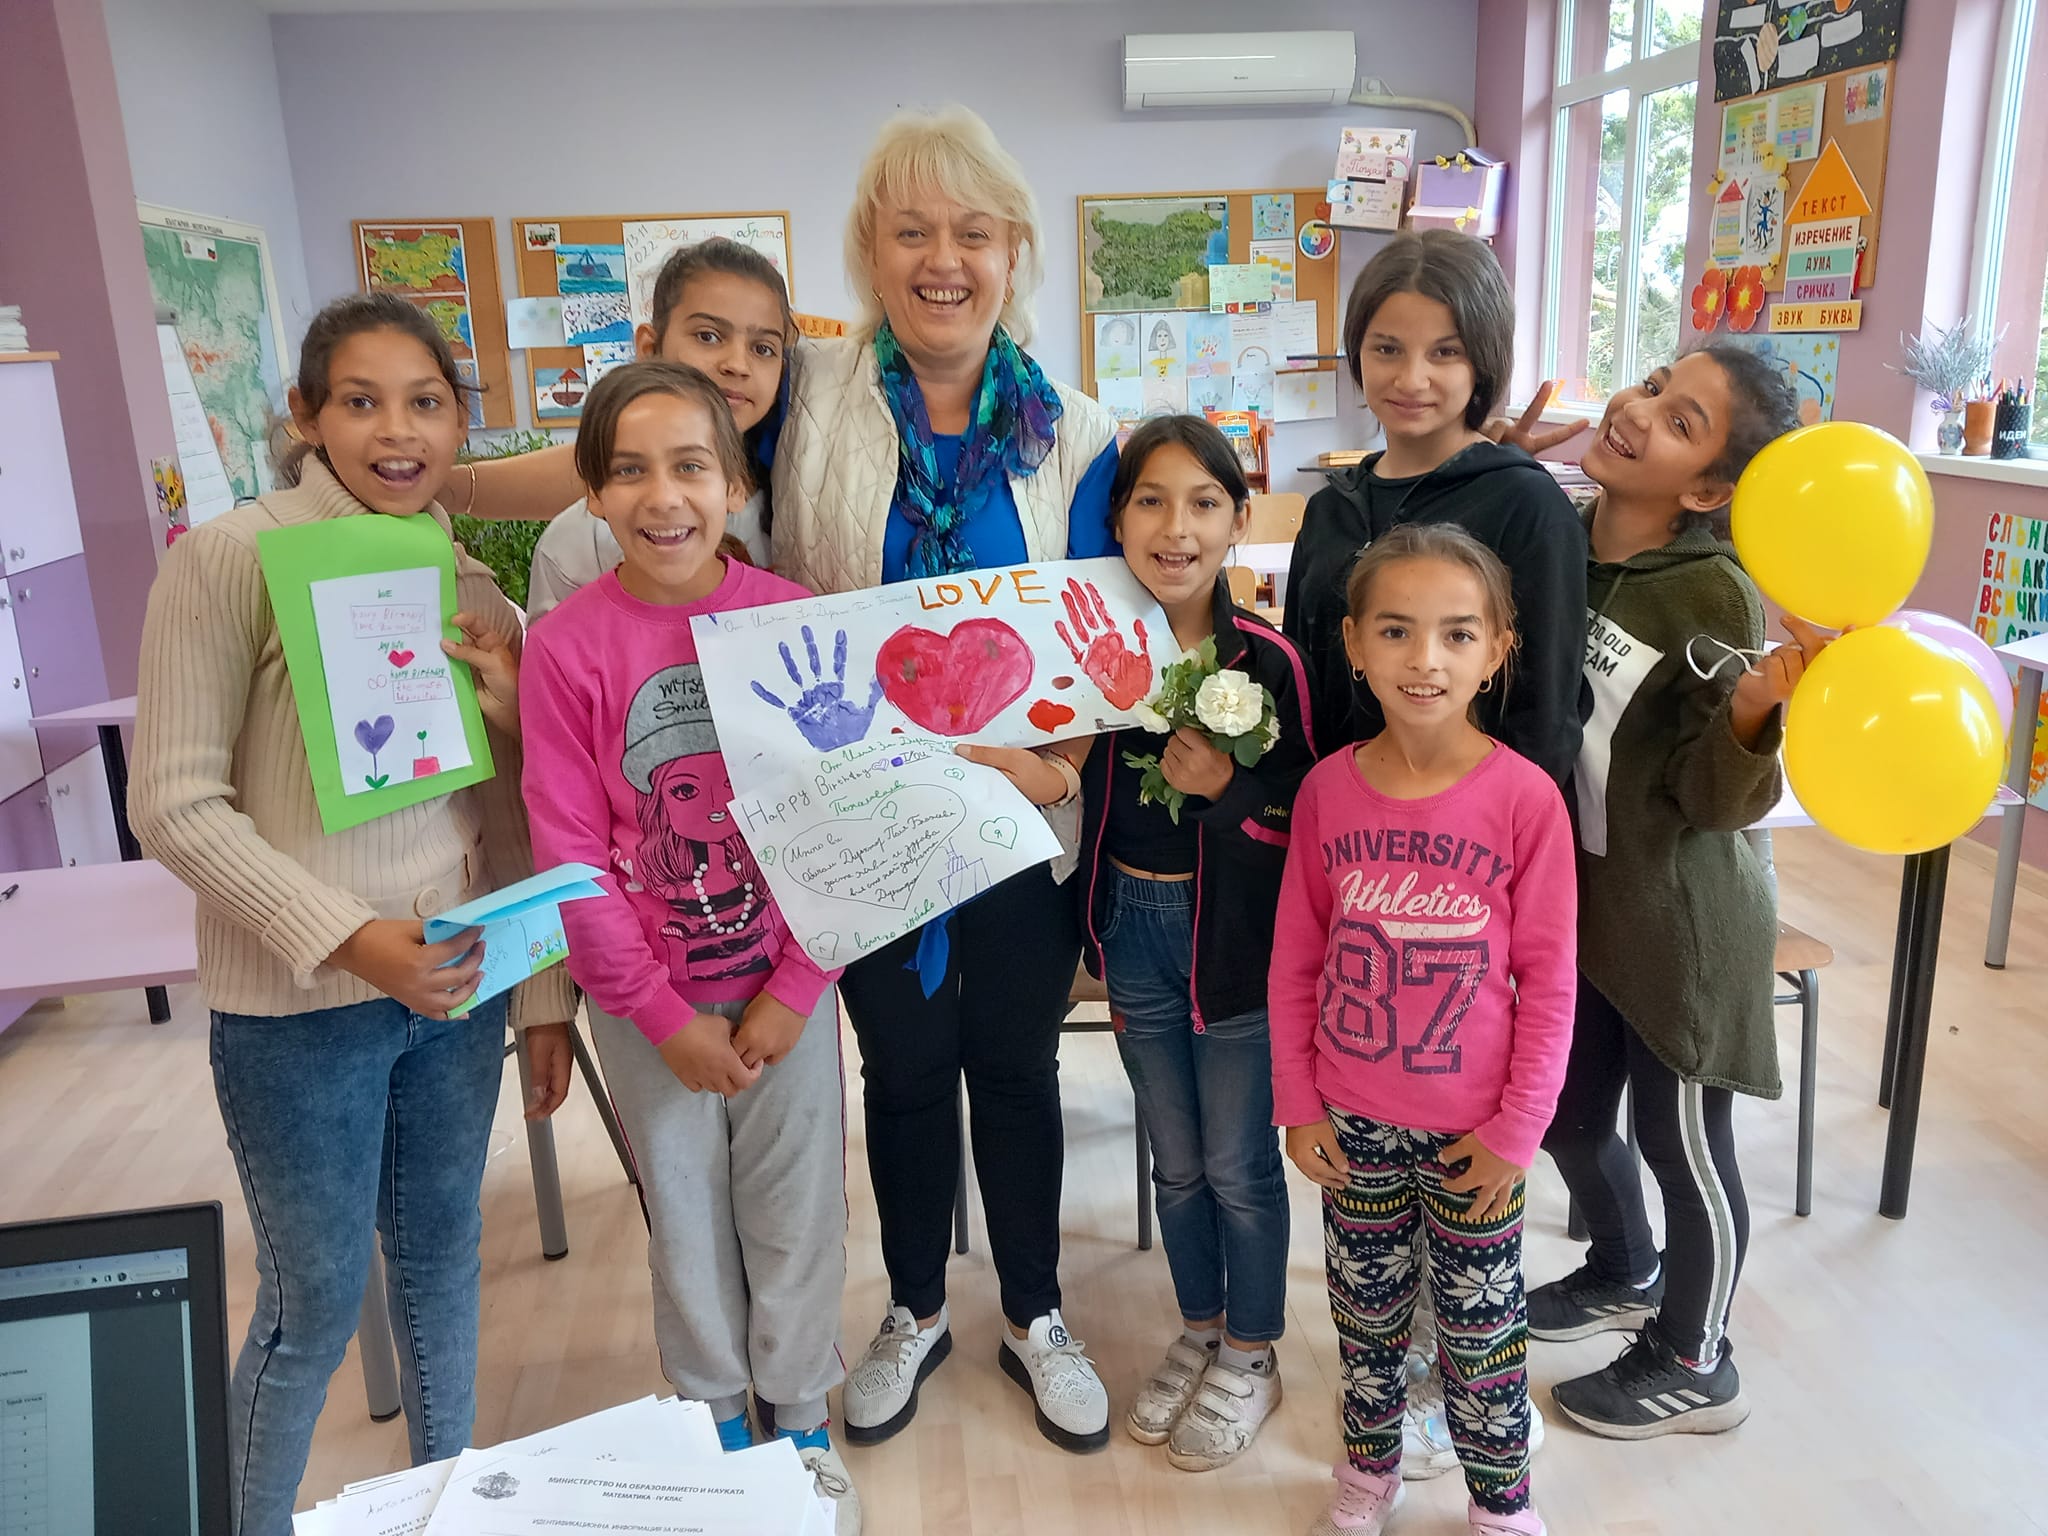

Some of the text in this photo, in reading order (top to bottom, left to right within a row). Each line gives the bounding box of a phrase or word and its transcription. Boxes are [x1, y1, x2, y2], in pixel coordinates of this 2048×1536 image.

[1802, 195, 1847, 216] ТЕКСТ
[652, 223, 689, 241] Ден
[1795, 225, 1852, 246] ИЗРЕЧЕНИЕ
[1805, 255, 1831, 272] ДУМА
[1796, 283, 1835, 300] СРИЧКА
[1777, 308, 1853, 325] ЗВУК БУКВА
[1999, 430, 2027, 442] ИДЕИ
[1982, 548, 2048, 590] ЕДНАК
[917, 569, 1051, 611] LOVE
[1603, 633, 1631, 657] OLD
[741, 789, 811, 832] Happy
[1339, 869, 1490, 917] Athletics
[1320, 918, 1489, 1075] 87
[548, 1477, 614, 1488] МИНИСТЕРСТВО
[615, 1481, 627, 1489] НА
[628, 1482, 699, 1493] ОБРАЗОВАНИЕТО
[602, 1491, 651, 1500] МАТЕМАТИКА
